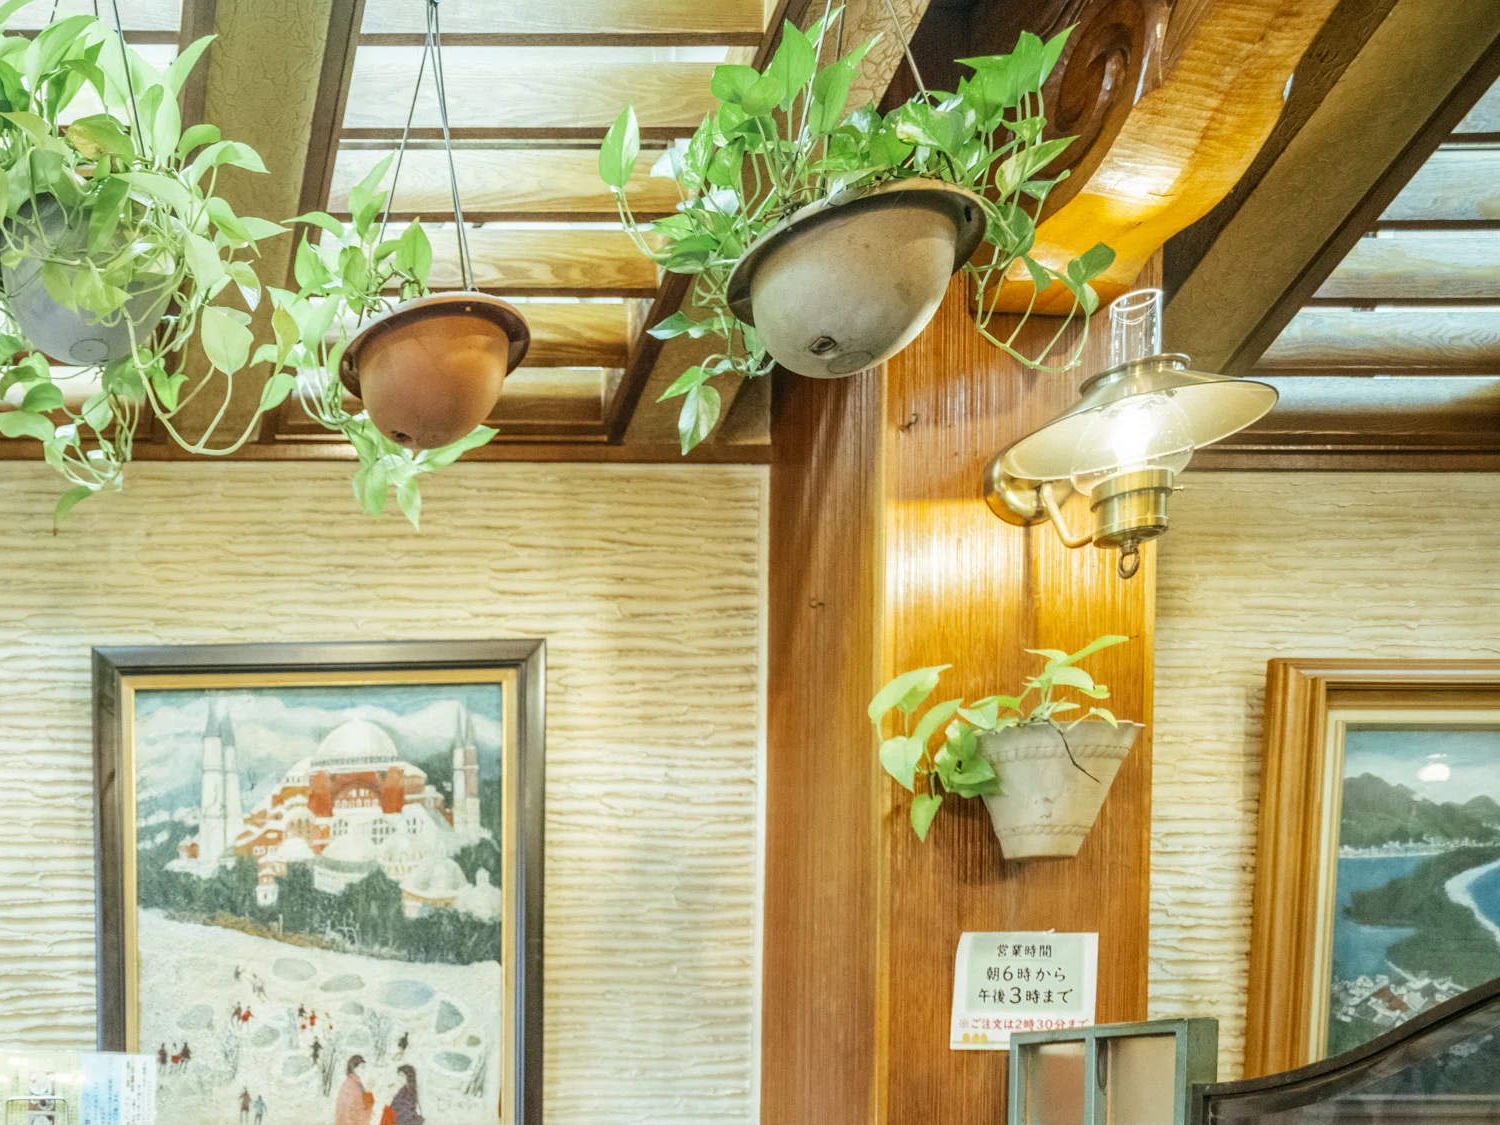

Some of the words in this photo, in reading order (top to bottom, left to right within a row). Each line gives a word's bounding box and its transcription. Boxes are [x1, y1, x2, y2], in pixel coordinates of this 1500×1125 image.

[997, 944, 1052, 958] 営業時間
[986, 965, 1066, 982] 朝6時から
[978, 986, 1073, 1004] 午後3時まで
